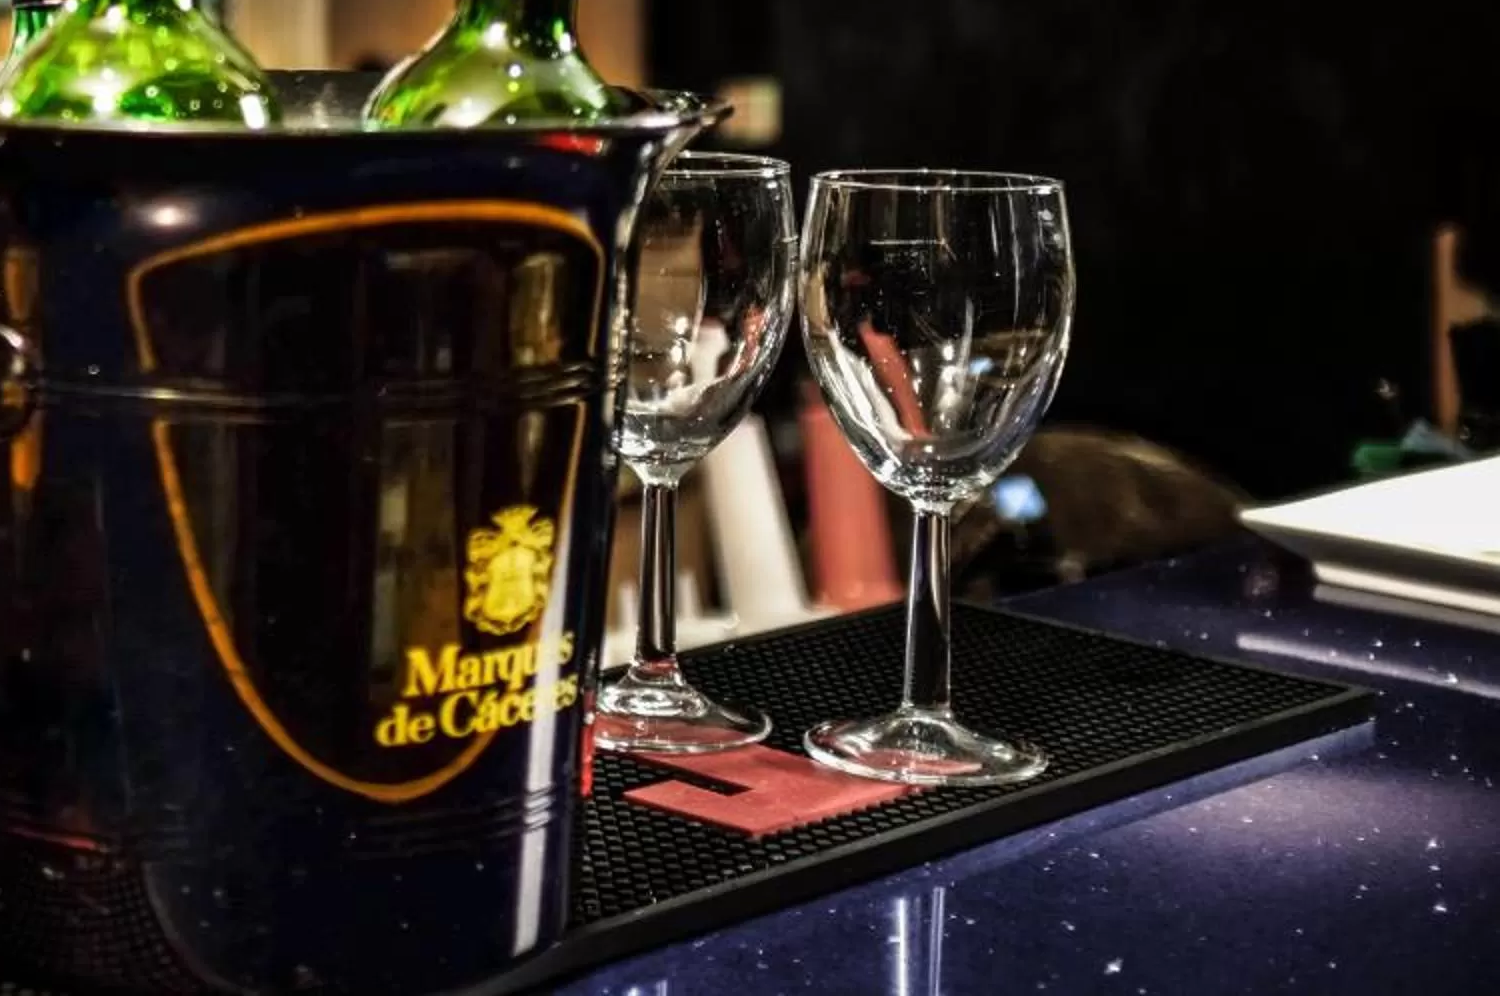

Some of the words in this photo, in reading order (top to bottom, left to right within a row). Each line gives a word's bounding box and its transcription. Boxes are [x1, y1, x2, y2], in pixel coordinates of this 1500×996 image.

[402, 631, 575, 697] Marqus
[374, 704, 436, 747] de
[439, 673, 578, 738] Cácees
